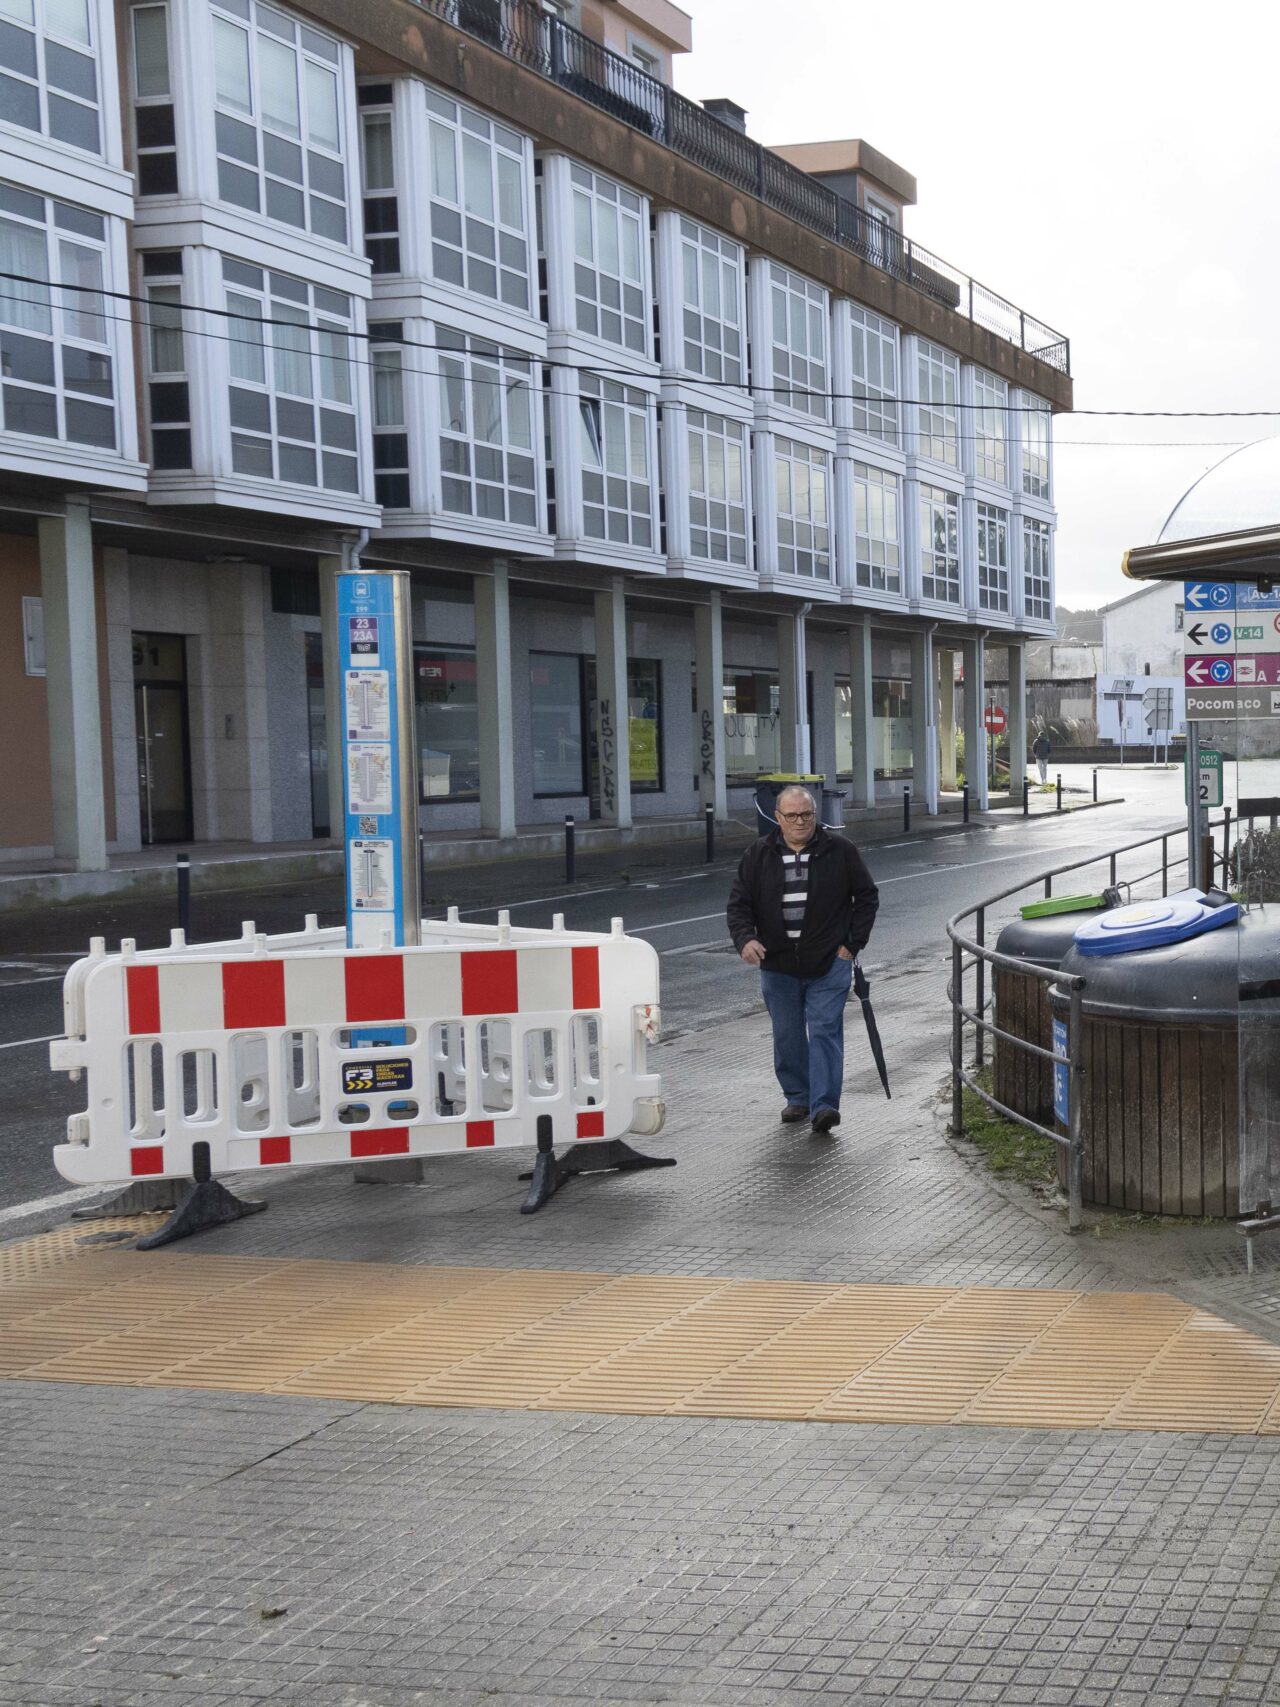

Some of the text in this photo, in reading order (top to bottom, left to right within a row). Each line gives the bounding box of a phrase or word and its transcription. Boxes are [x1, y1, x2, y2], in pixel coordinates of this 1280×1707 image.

[355, 618, 370, 629] 23
[353, 630, 375, 641] 23A
[1236, 628, 1263, 639] V-14
[1256, 672, 1267, 682] A
[1187, 698, 1261, 710] Pocomaco
[345, 1069, 374, 1082] F3
